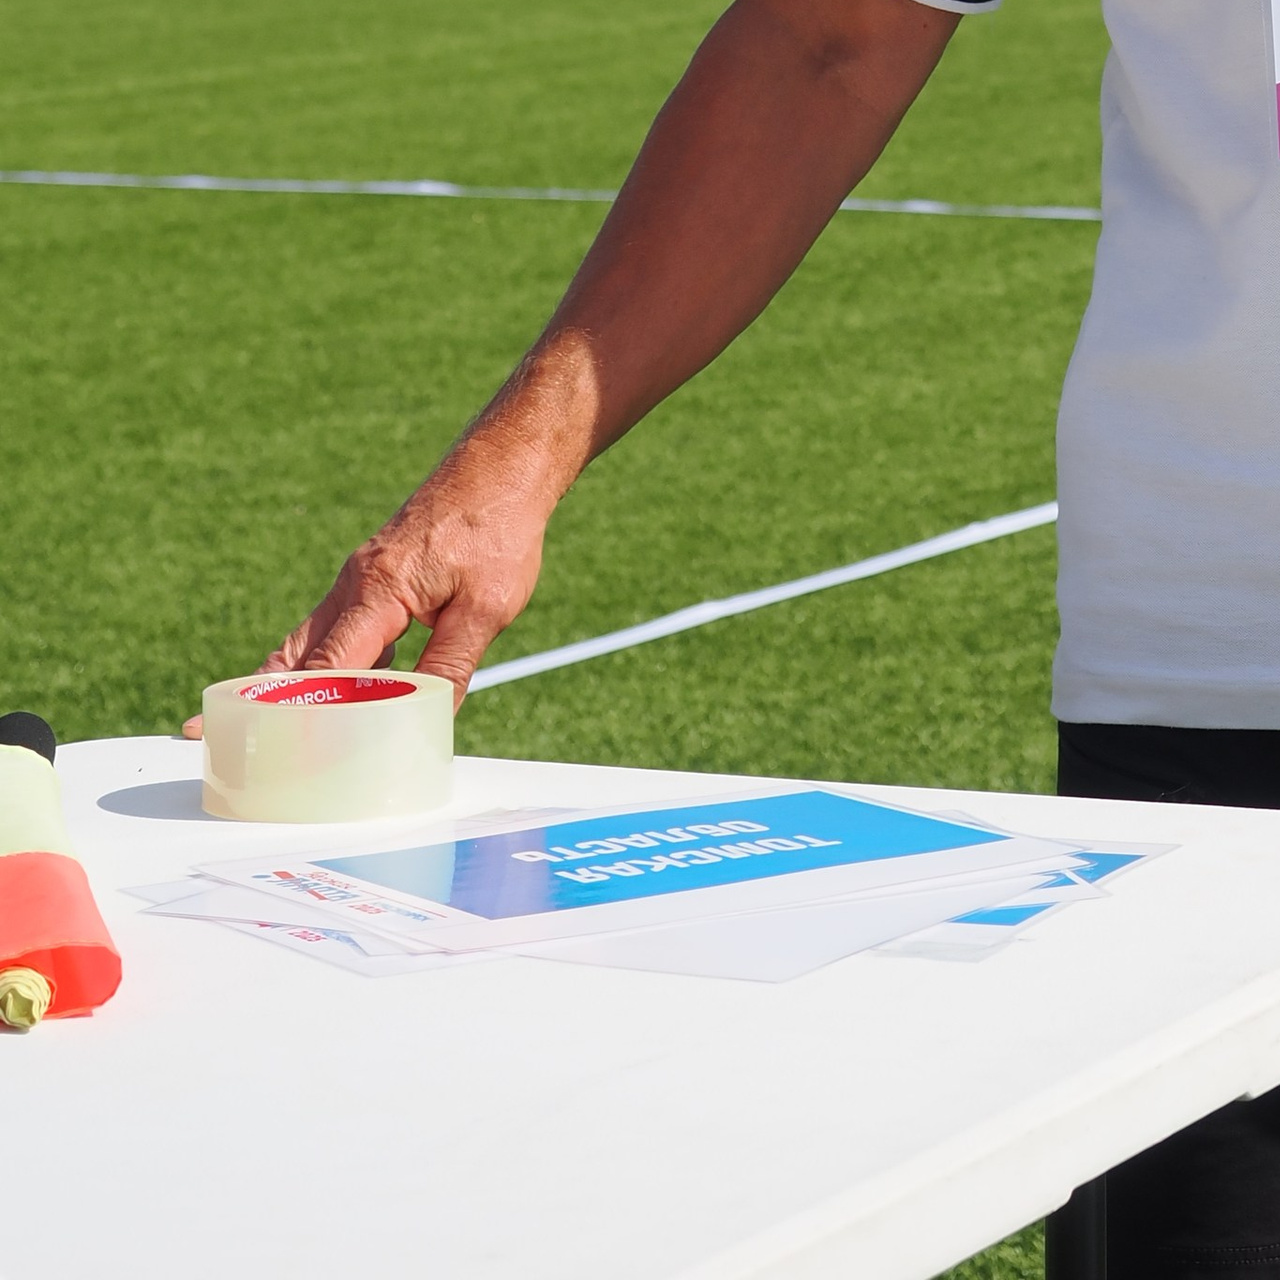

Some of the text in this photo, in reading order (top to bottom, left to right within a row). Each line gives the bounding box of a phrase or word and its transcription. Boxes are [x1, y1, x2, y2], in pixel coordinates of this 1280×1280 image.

[277, 687, 342, 705] OVAROLL
[511, 820, 771, 863] ОБЛАСТЬ
[553, 835, 843, 884] ТОМСКАЯ
